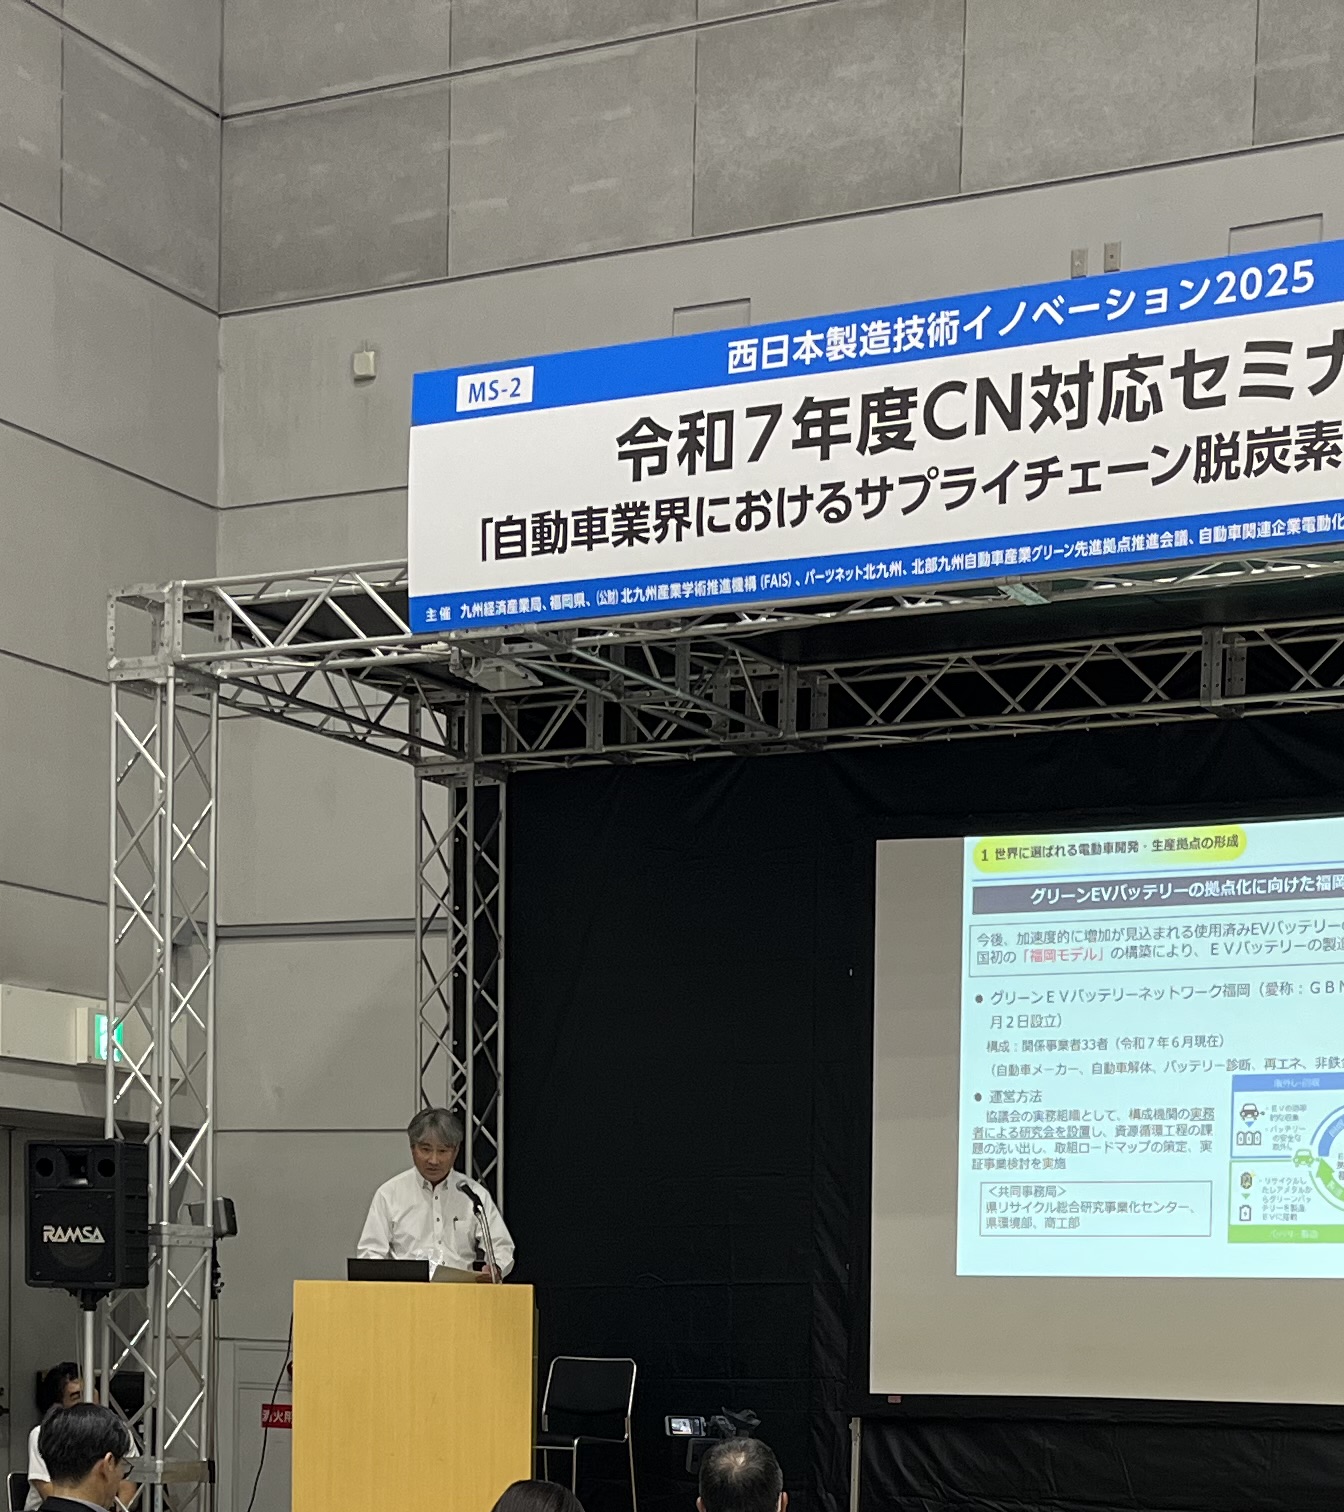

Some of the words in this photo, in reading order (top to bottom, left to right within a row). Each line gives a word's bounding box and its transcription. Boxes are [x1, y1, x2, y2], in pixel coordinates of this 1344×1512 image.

[727, 258, 1316, 375] 西日本製造技術イノベーション2025
[467, 376, 523, 405] MS-2
[425, 607, 452, 623] 主催
[989, 1089, 1043, 1104] 運営方法
[42, 1225, 106, 1245] RAMSA
